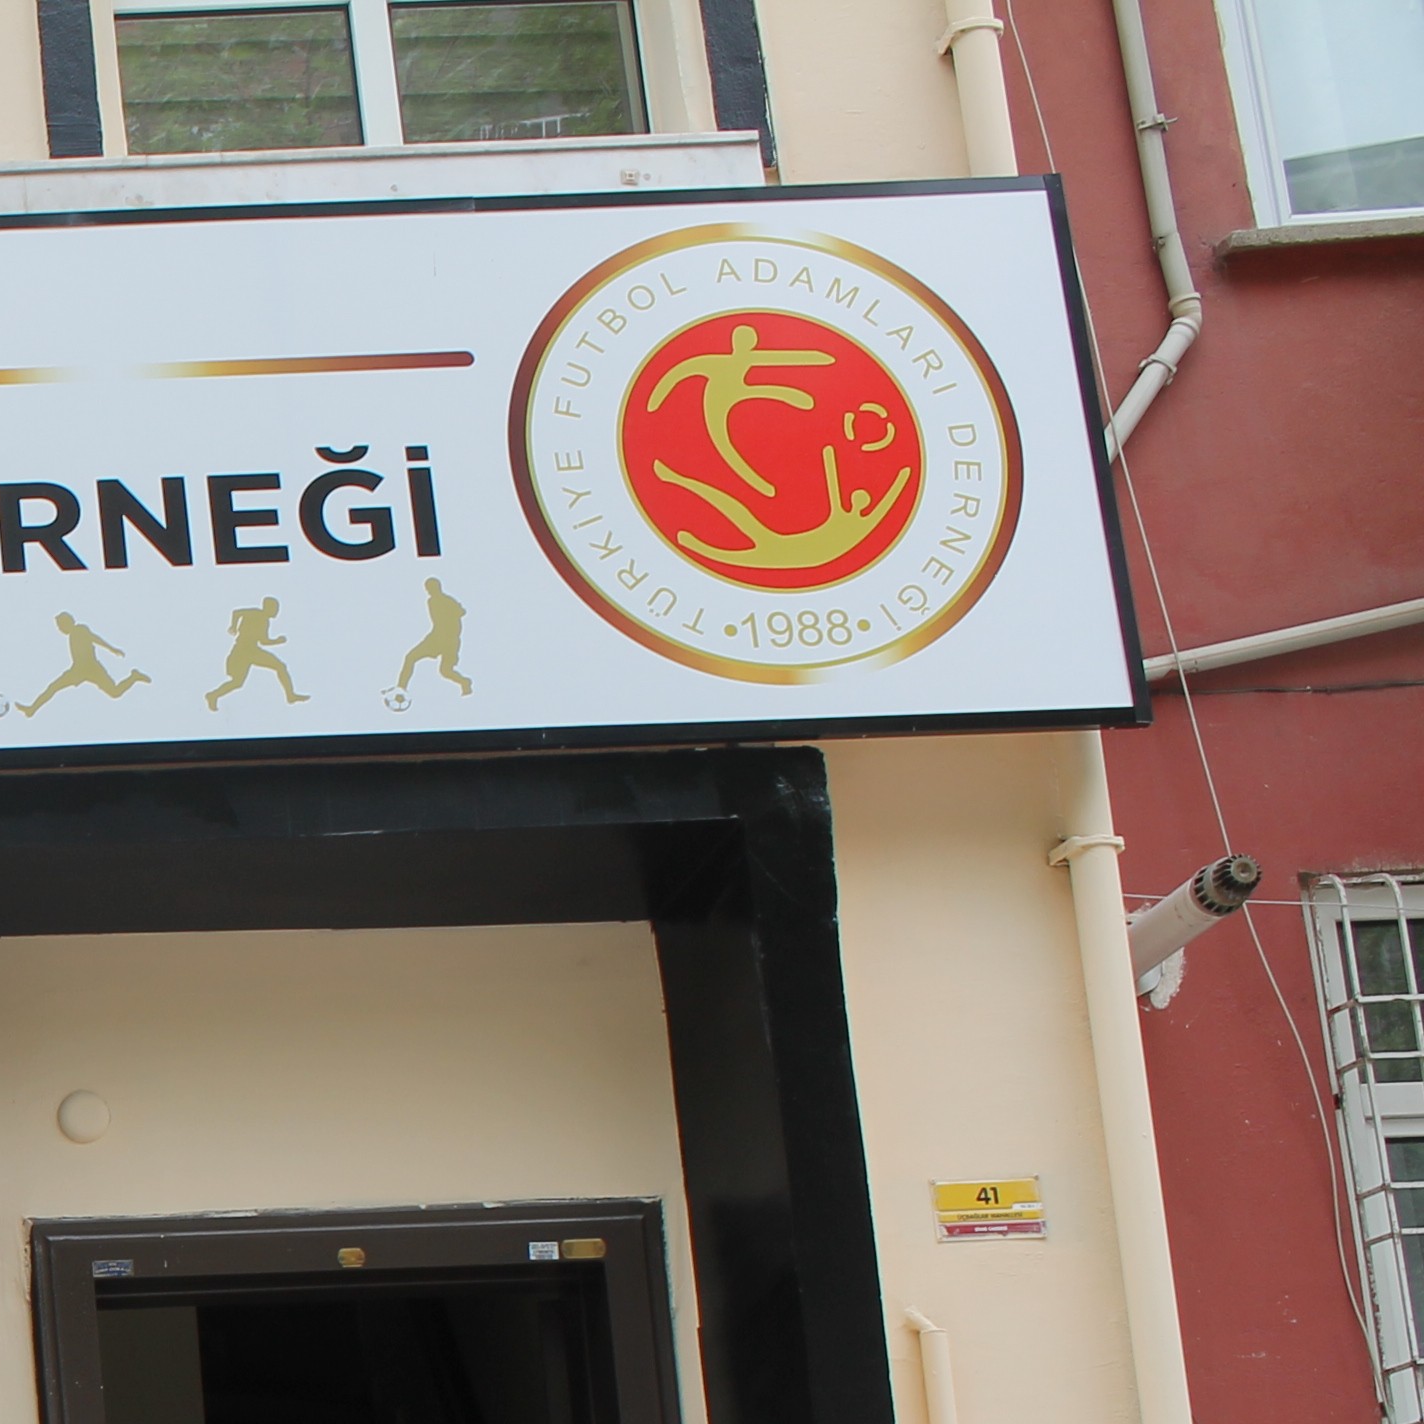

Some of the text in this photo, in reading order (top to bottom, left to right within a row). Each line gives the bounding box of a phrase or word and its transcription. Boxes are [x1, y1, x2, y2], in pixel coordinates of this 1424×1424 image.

[554, 257, 982, 636] TÜRKİYE FUTBOL ADAMLARI DERNEĞİ
[740, 608, 854, 649] 1988
[975, 1186, 1000, 1206] 41
